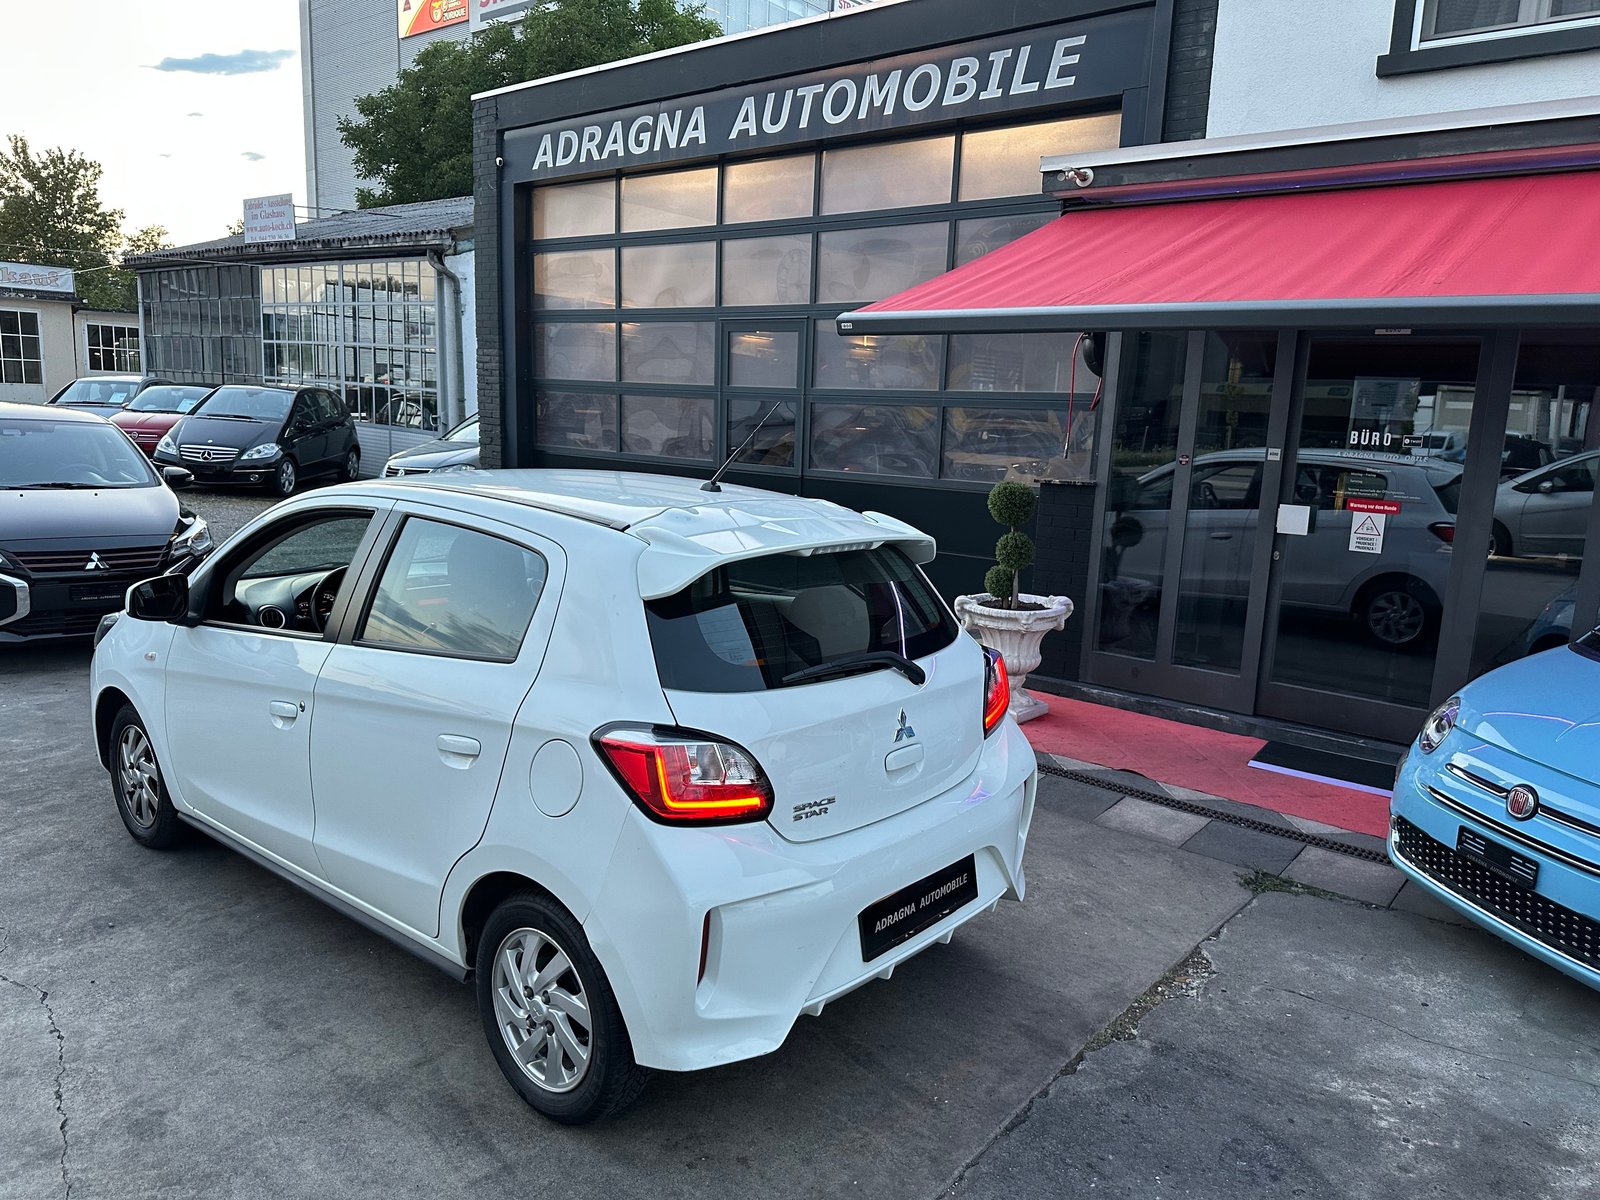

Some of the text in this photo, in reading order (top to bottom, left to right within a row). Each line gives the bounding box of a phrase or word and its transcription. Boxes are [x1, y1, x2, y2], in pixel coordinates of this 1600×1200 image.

[532, 34, 1087, 170] ADRAGNA AUTOMOBILE
[260, 209, 286, 219] Glashaus
[246, 220, 293, 232] www.auto-koch.ch
[1350, 429, 1392, 446] BÜRO
[793, 796, 836, 813] SPACE
[793, 807, 829, 822] STAR
[874, 873, 968, 934] ADRAGNA AUTOMOBILE
